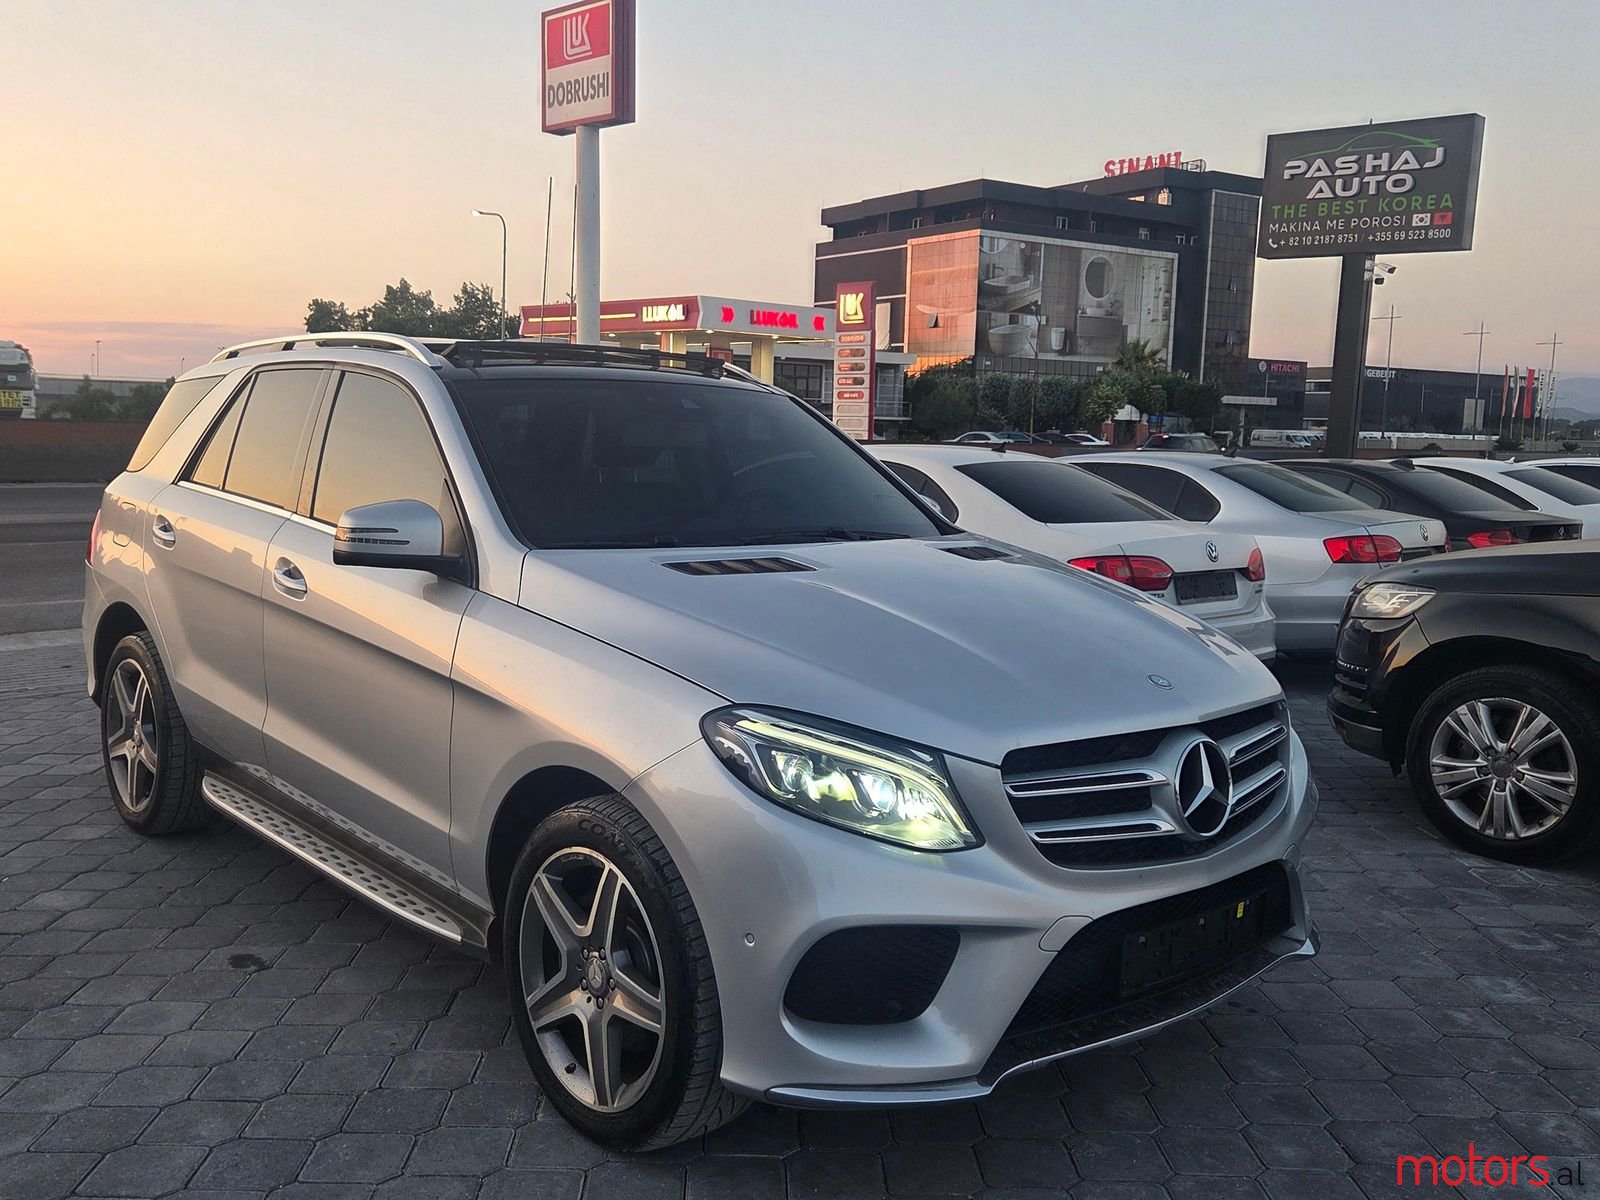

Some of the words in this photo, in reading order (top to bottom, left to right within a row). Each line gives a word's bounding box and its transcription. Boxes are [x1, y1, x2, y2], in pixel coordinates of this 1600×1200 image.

[547, 72, 609, 109] DOBRUSHI
[1104, 151, 1182, 177] SINANI
[1283, 146, 1445, 180] PASHAJ
[1306, 173, 1416, 200] AUTO
[1272, 203, 1308, 219] THE
[1318, 198, 1367, 217] BEST
[1379, 192, 1453, 213] KOREA
[1269, 220, 1320, 234] MAKINA
[1326, 218, 1345, 231] ME
[1350, 215, 1406, 229] POROSI
[1288, 236, 1300, 246] 82
[1302, 235, 1312, 246] 10
[1314, 234, 1335, 245] 2187
[1337, 233, 1358, 244] 8751
[1367, 231, 1392, 242] +355
[1394, 230, 1406, 241] 69
[1407, 229, 1425, 240] 523
[1427, 228, 1452, 239] 8500
